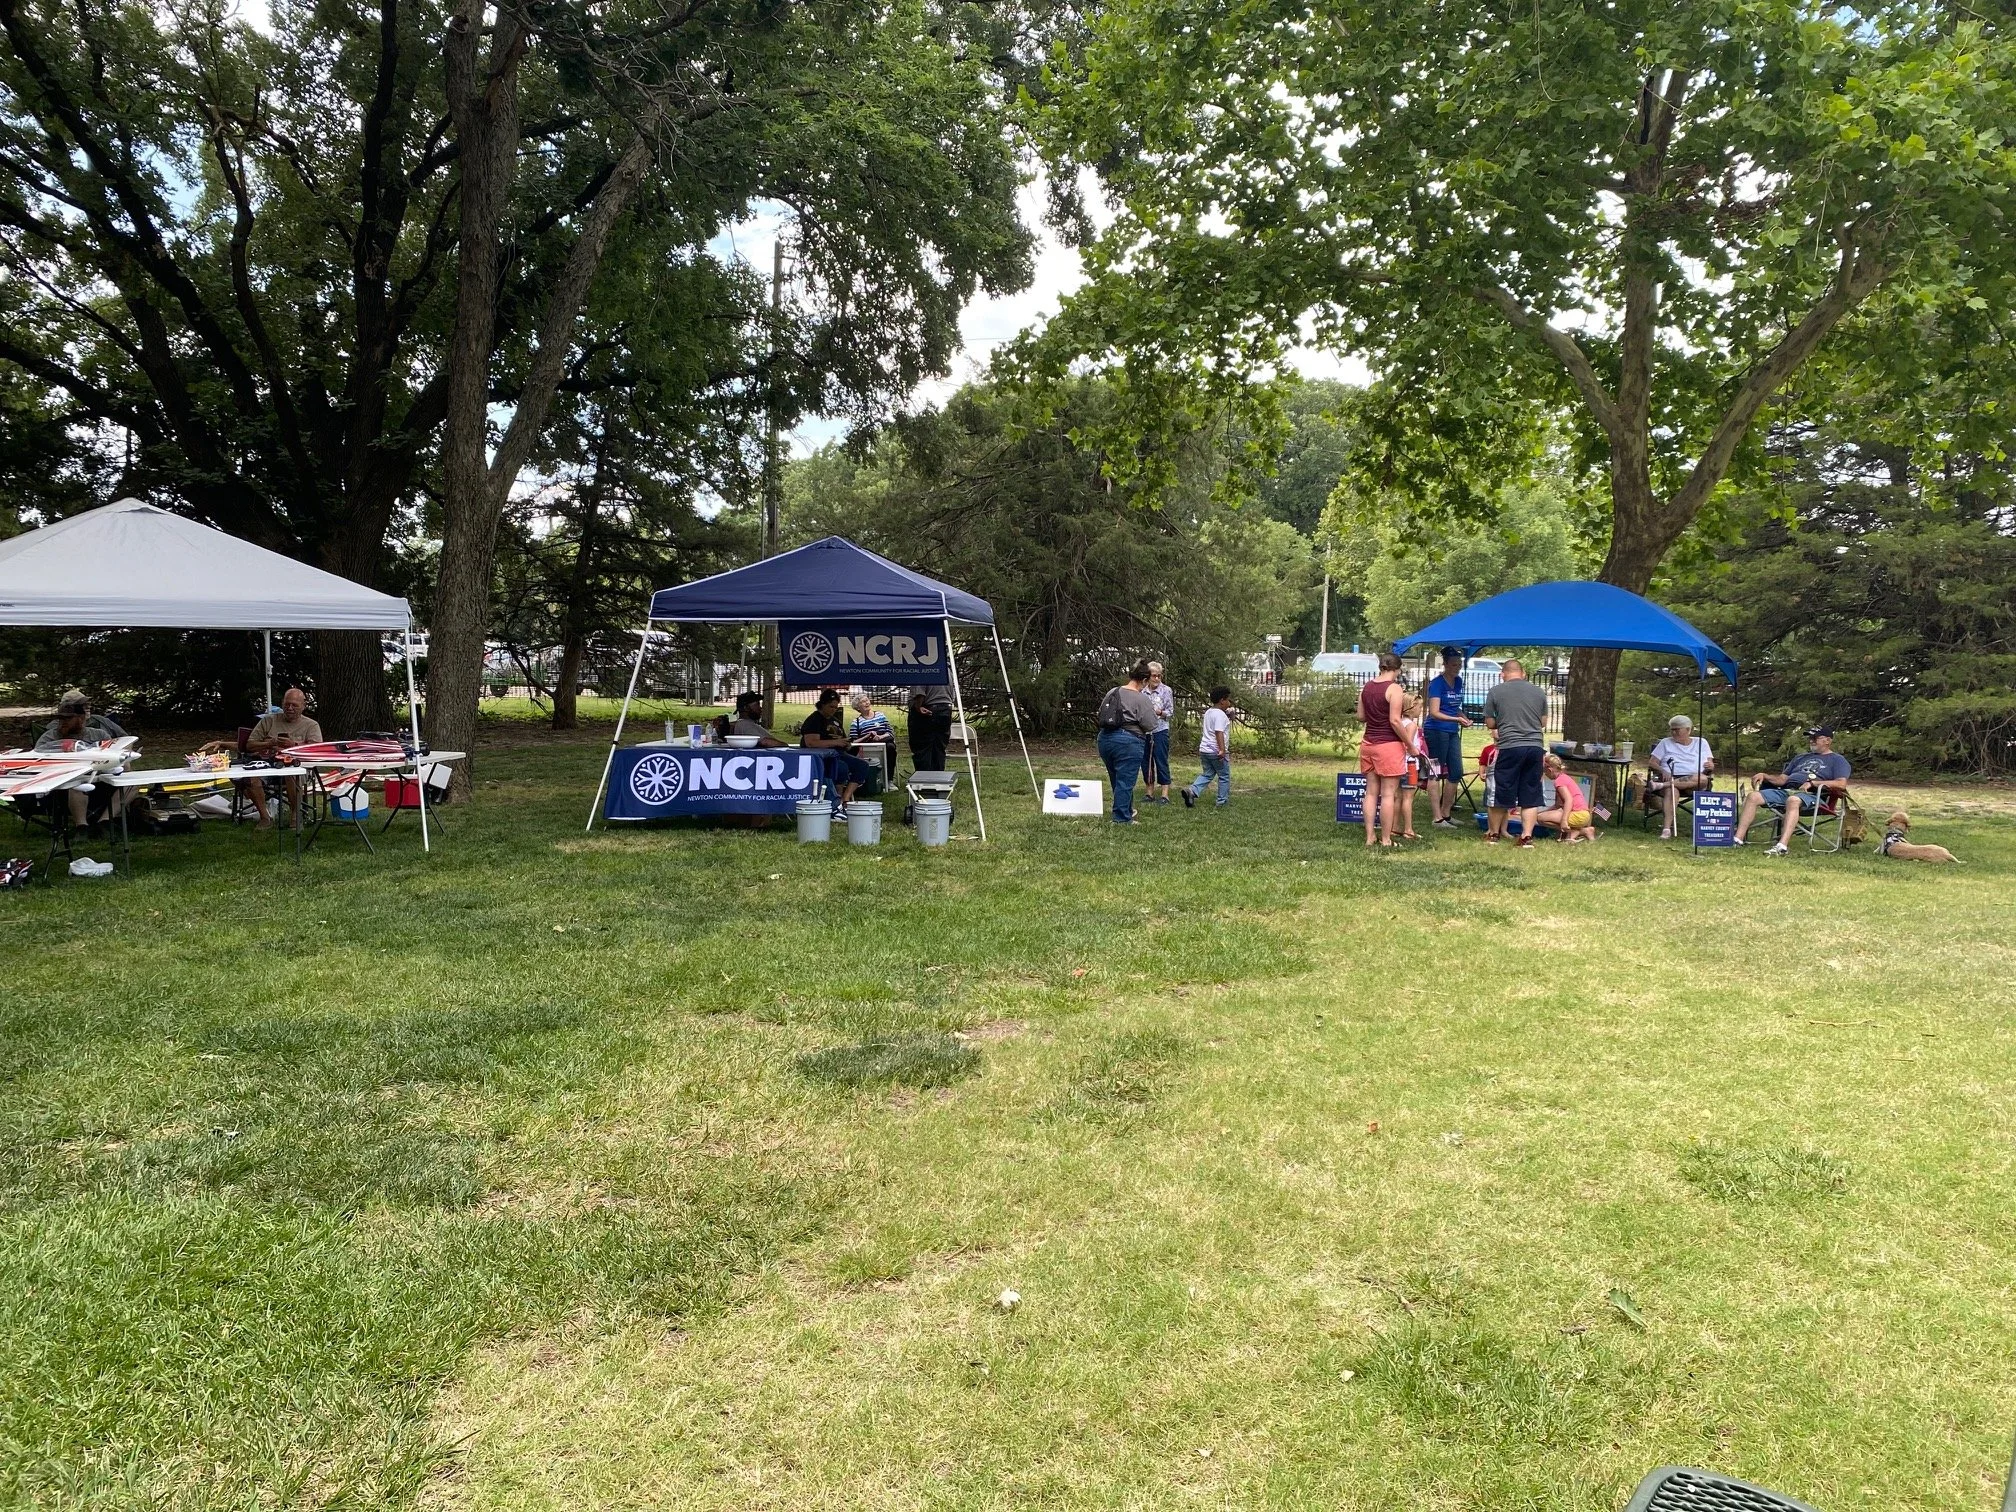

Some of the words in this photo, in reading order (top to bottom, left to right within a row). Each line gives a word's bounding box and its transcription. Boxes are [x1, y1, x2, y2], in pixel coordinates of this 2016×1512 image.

[838, 635, 939, 665] NCRJ
[688, 755, 812, 791] NCRJ
[1339, 788, 1358, 797] Amy
[1700, 797, 1720, 805] ELECT
[1696, 807, 1709, 818] Amy
[1710, 808, 1732, 816] Perkins
